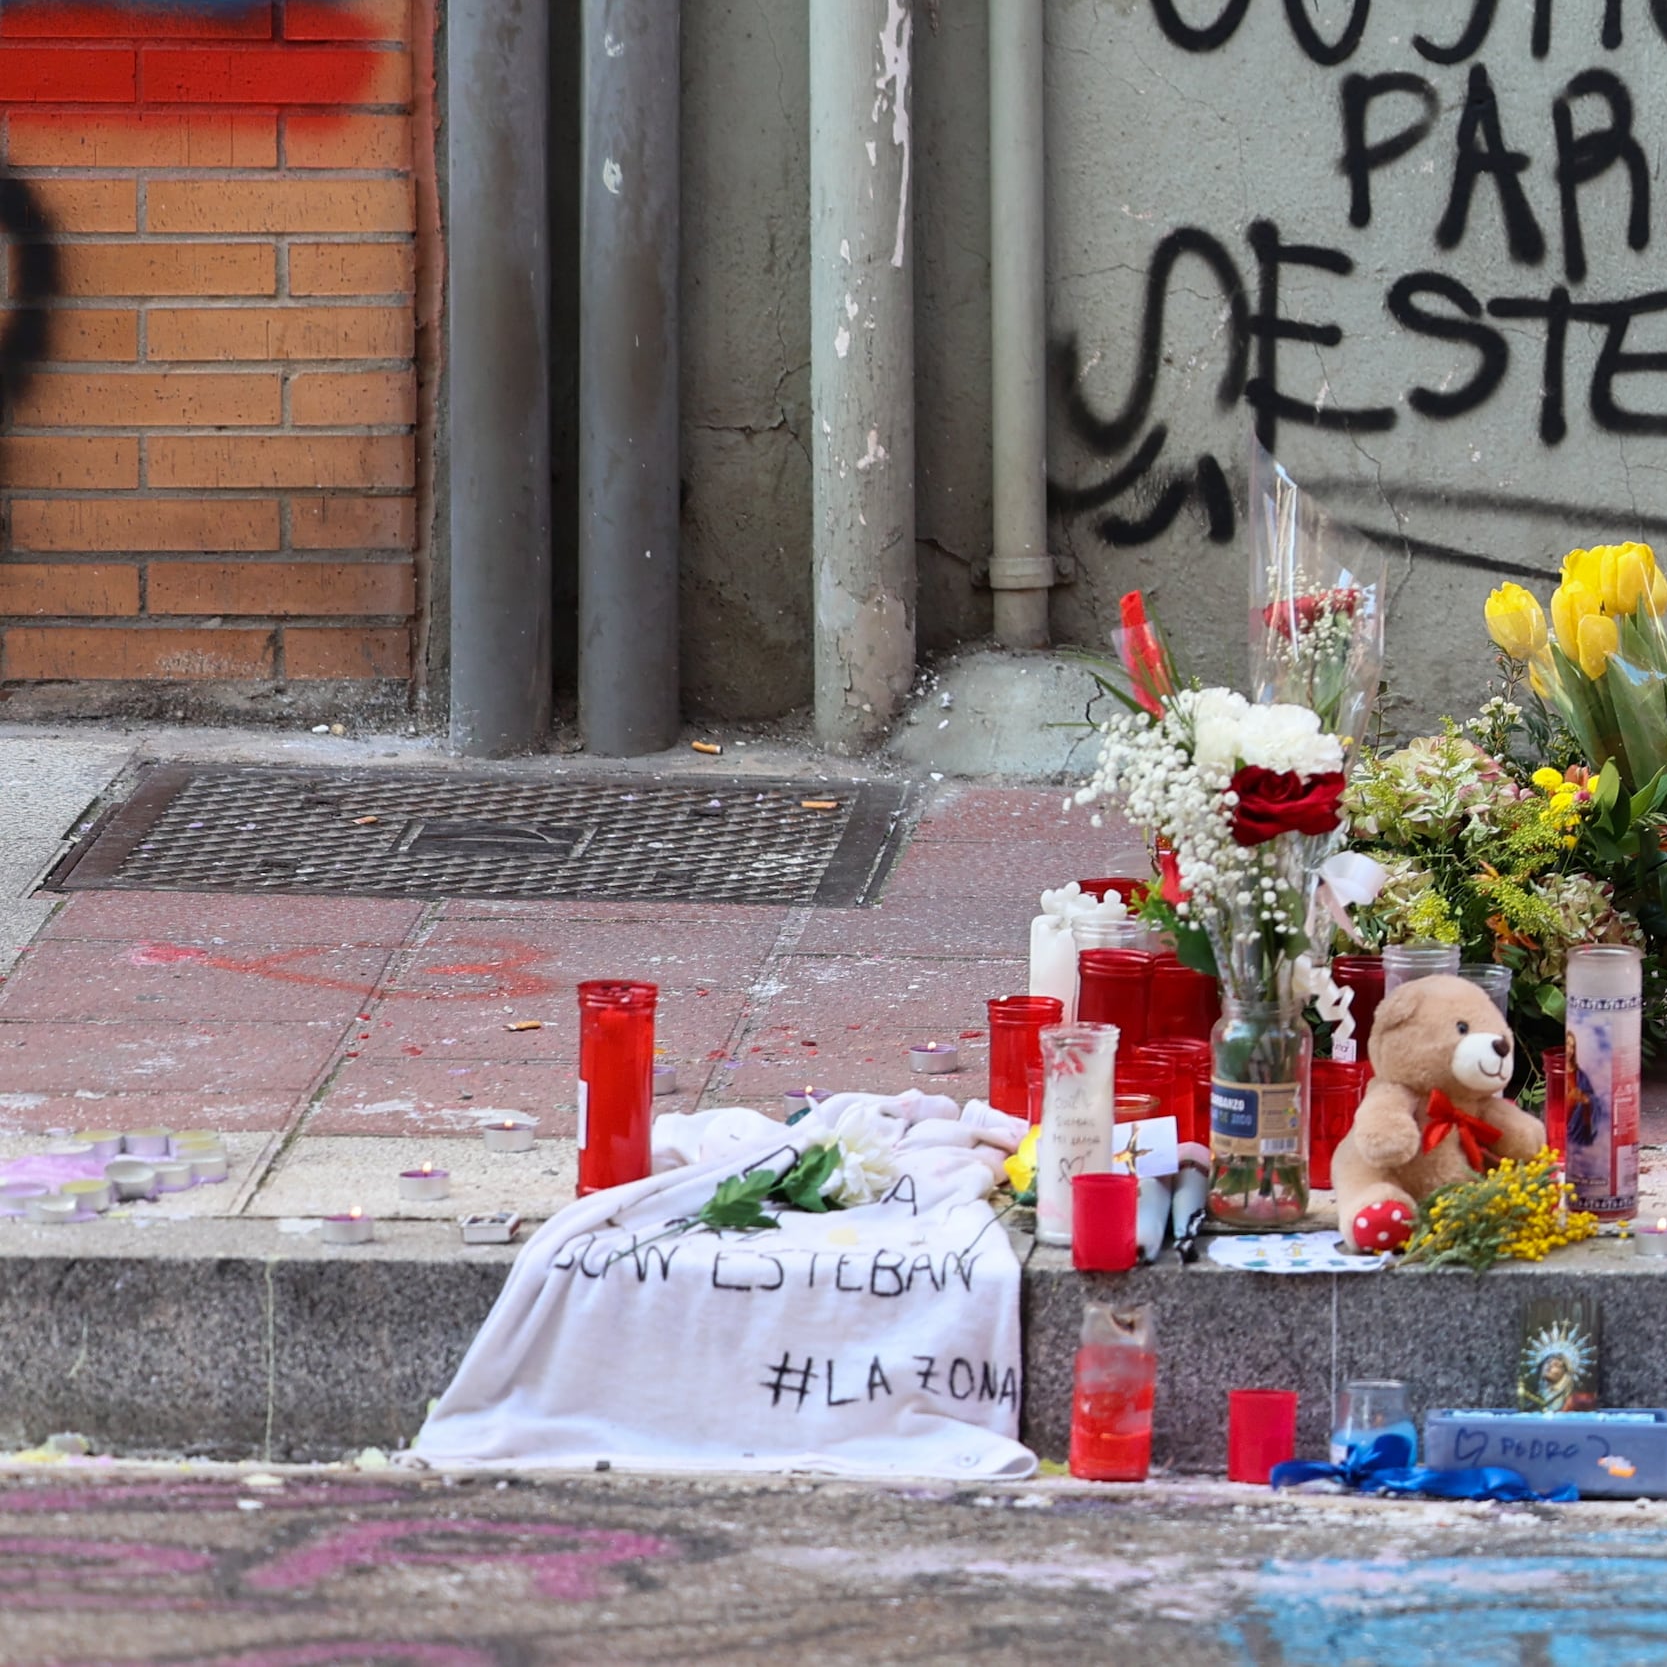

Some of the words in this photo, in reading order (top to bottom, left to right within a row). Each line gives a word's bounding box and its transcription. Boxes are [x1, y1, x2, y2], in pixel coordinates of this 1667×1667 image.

[712, 1247, 982, 1298] ESTEBAN
[764, 1349, 892, 1412] #LA
[915, 1353, 1020, 1413] ZONA
